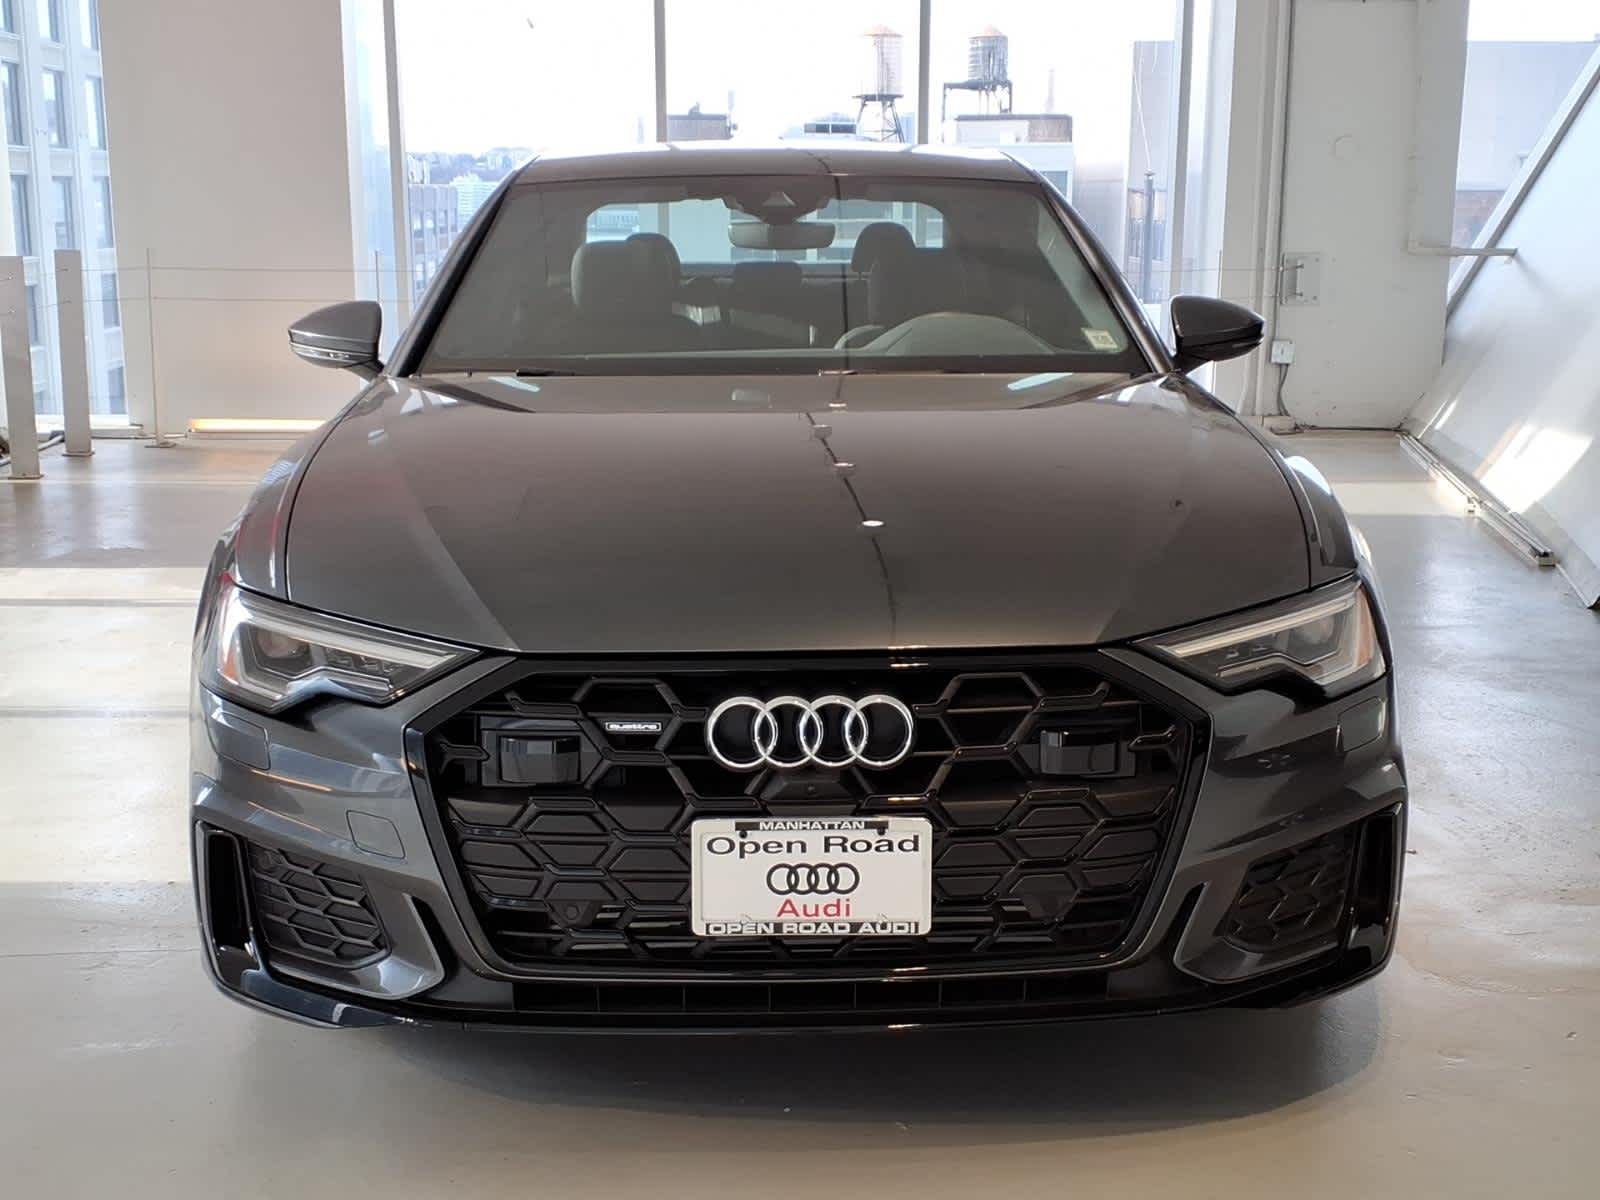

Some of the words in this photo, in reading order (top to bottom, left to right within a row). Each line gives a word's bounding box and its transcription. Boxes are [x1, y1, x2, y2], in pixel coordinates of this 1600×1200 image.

[760, 821, 865, 831] MANHATTAN
[707, 836, 807, 859] Open
[824, 835, 919, 853] Road
[777, 898, 850, 917] Audi
[709, 923, 774, 934] OPEN
[782, 922, 850, 934] ROAD
[858, 922, 915, 934] AUDI
